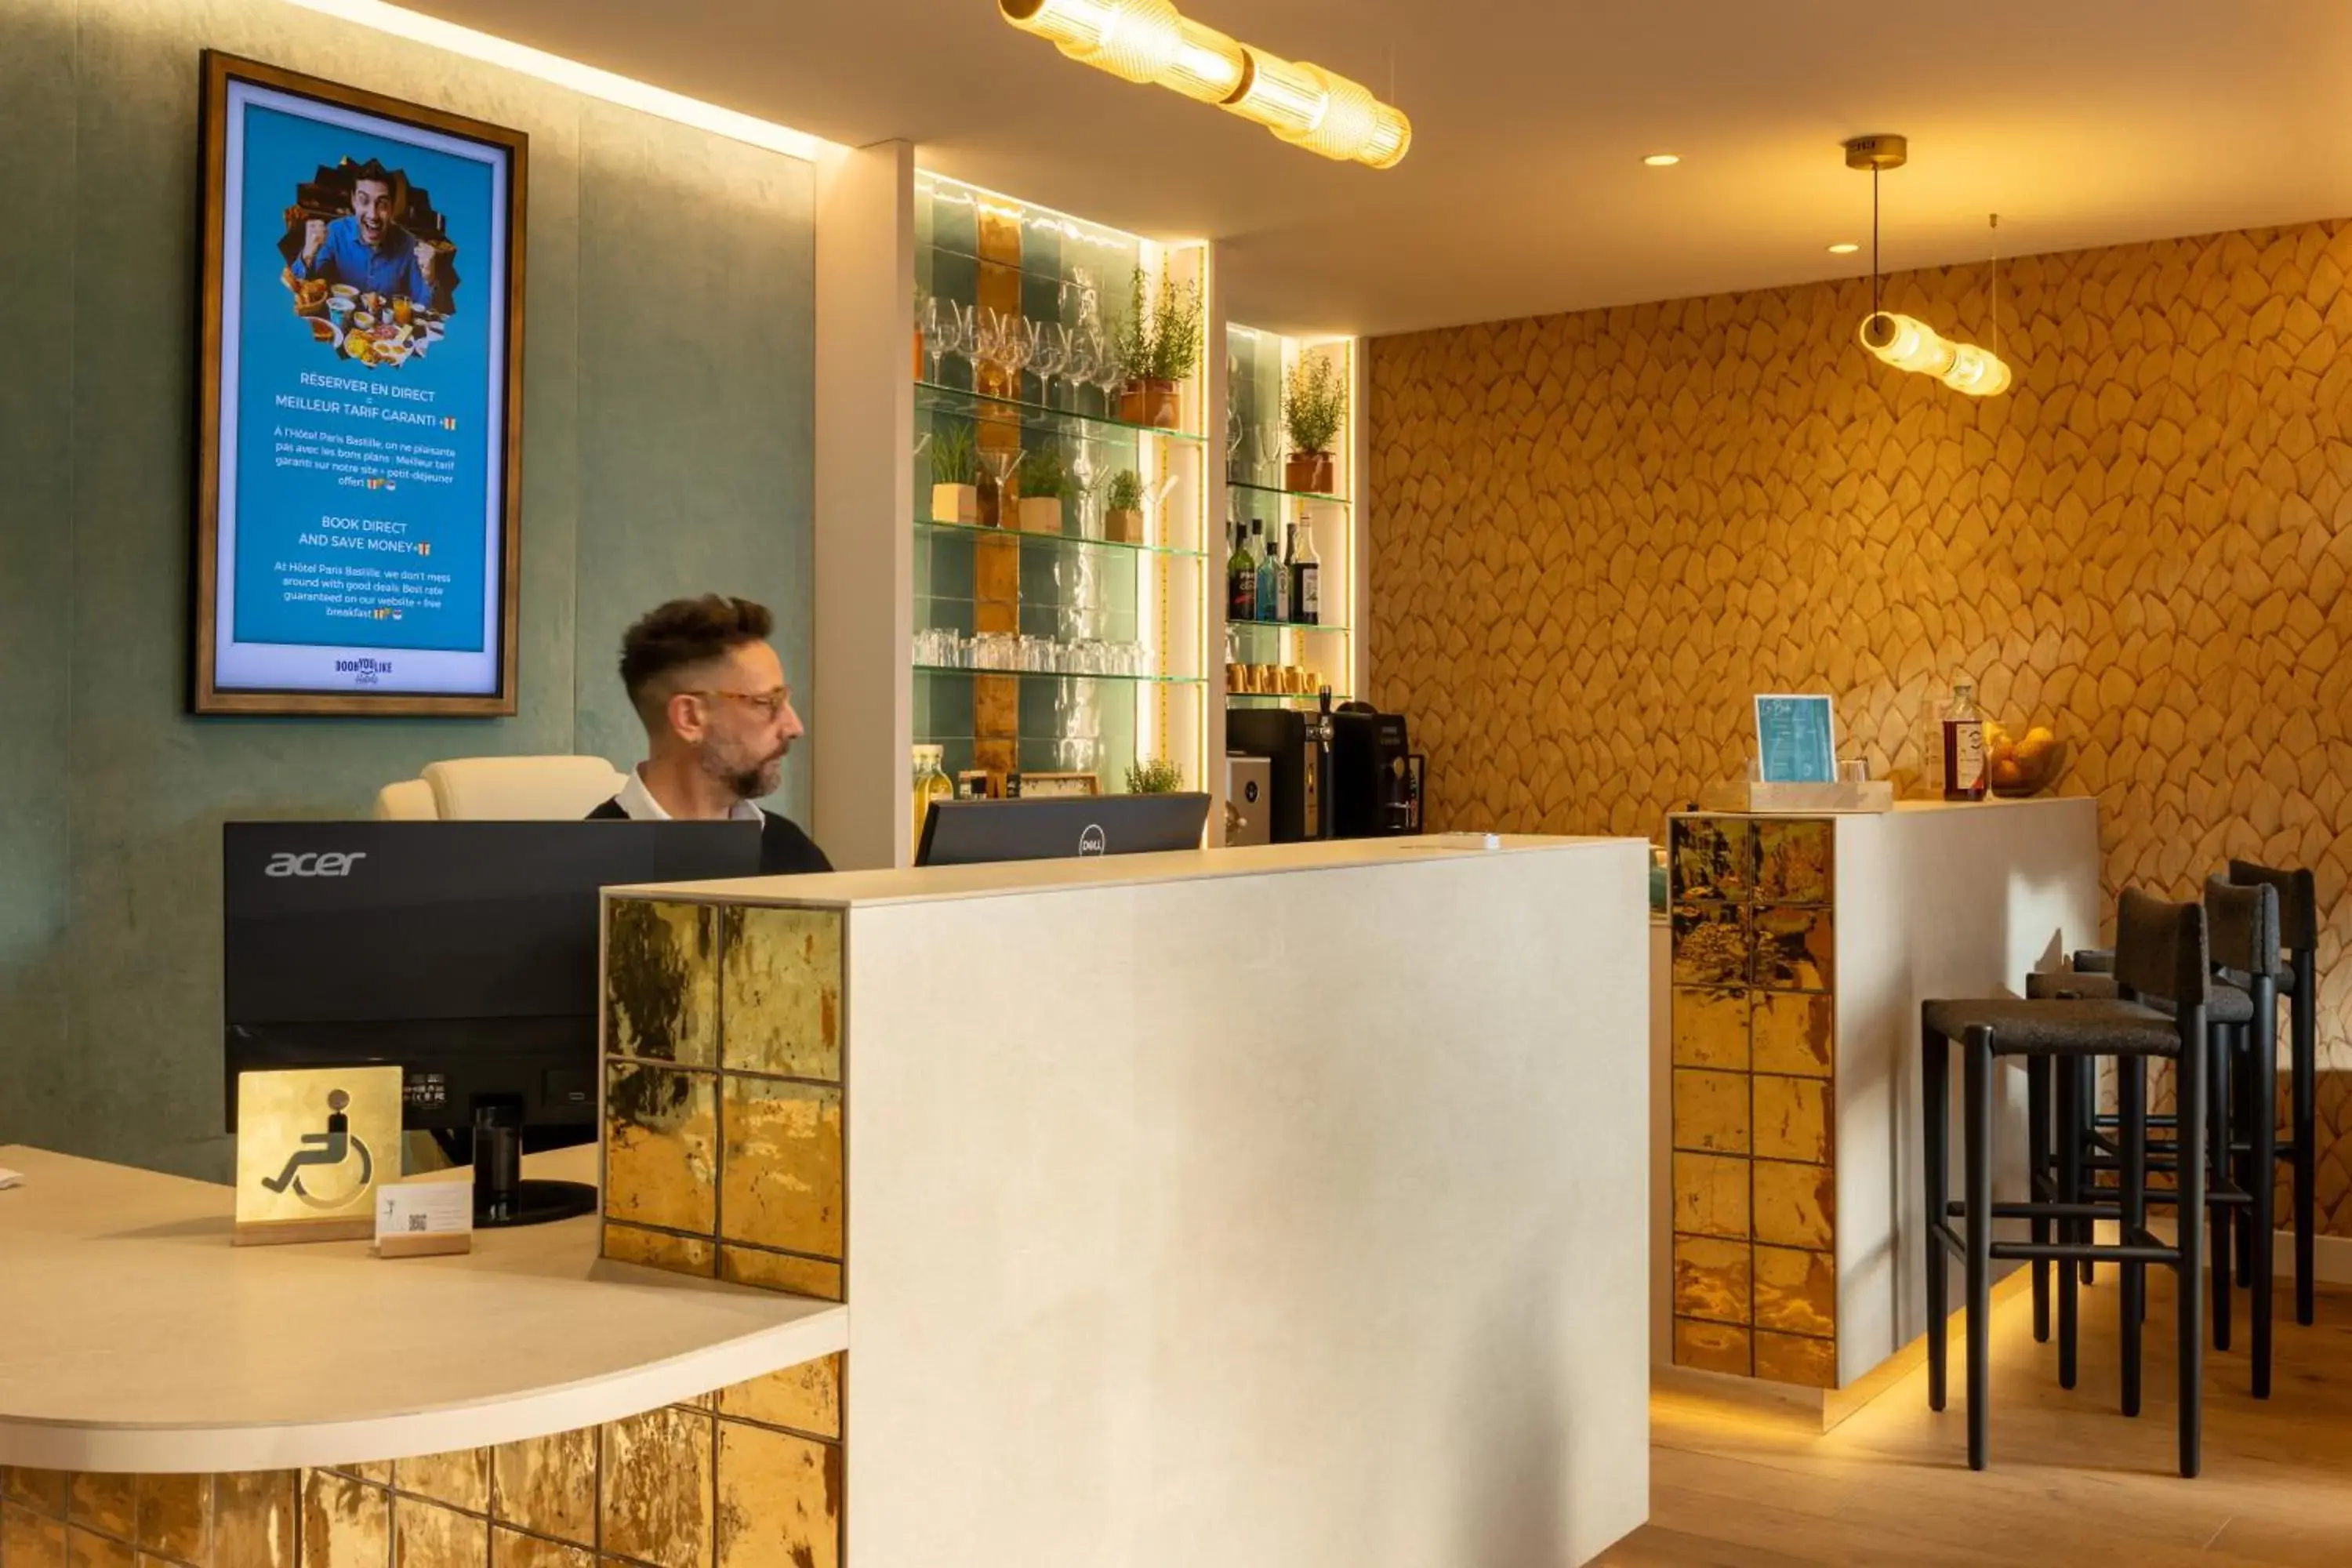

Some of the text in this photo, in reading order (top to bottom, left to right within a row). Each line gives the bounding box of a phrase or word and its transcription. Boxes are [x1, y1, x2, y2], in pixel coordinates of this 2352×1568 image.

[300, 372, 436, 402] RÉSERVER EN DIRECT
[275, 394, 339, 413] MEILLEUR
[343, 404, 379, 419] TARIF
[382, 408, 436, 426] GARANTI
[319, 432, 343, 444] Paris
[386, 441, 397, 451] on
[400, 444, 412, 452] ne
[413, 445, 456, 459] plaisante
[275, 442, 294, 452] pas
[296, 445, 318, 455] avec
[321, 445, 335, 456] les
[337, 448, 361, 459] bons
[435, 460, 455, 471] tarif
[275, 457, 313, 468] garanti
[314, 461, 329, 470] sur
[332, 463, 358, 474] notre
[361, 466, 378, 475] site
[338, 475, 365, 487] offert
[321, 516, 408, 535] BOOK DIRECT
[299, 533, 328, 547] AND
[331, 535, 365, 550] SAVE
[274, 561, 287, 572] At
[289, 561, 317, 573] Hôtel
[318, 564, 343, 575] Paris
[384, 570, 399, 579] we
[401, 570, 424, 581] don't
[427, 573, 451, 583] mess
[283, 578, 319, 588] around
[321, 579, 343, 589] with
[346, 581, 371, 592] good
[402, 583, 423, 593] Best
[425, 586, 443, 596] rate
[283, 590, 343, 601] guaranteed
[345, 594, 357, 603] on
[378, 597, 414, 608] website
[423, 598, 441, 609] free
[326, 606, 371, 619] breakfast
[1083, 840, 1101, 851] DELL
[265, 852, 366, 877] acer
